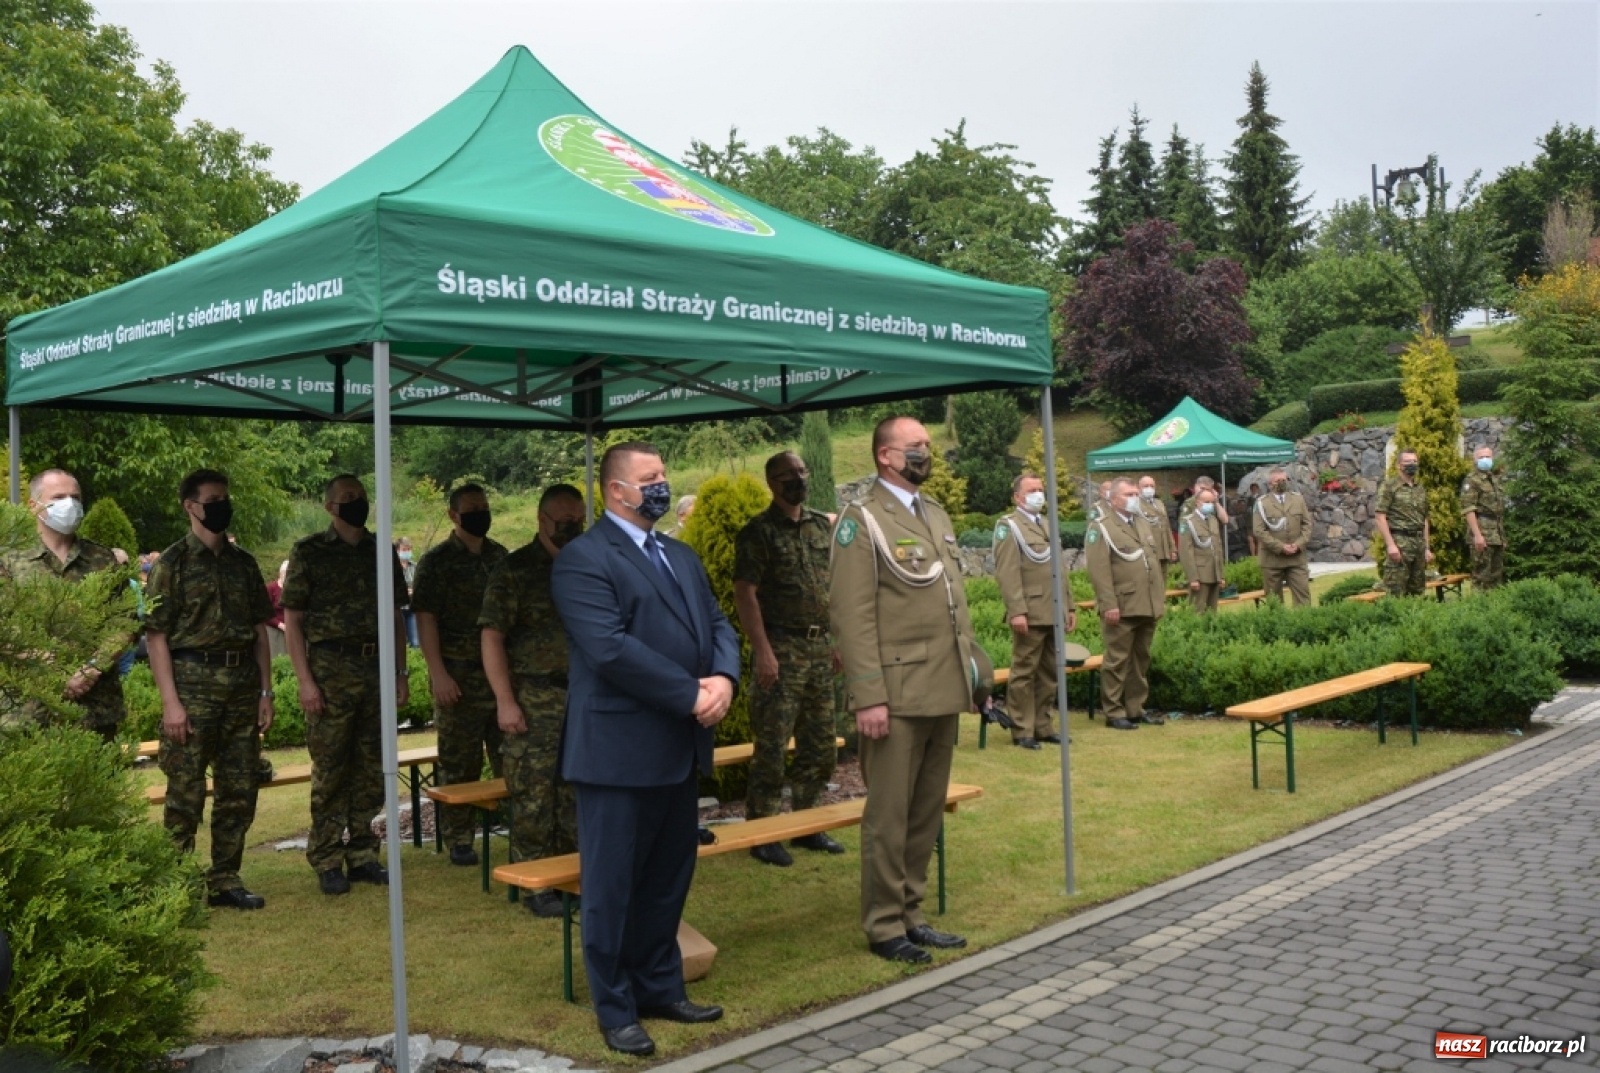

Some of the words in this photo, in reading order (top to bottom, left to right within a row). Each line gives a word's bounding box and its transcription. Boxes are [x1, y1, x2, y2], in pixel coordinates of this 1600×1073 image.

[46, 337, 80, 362] Oddział
[82, 329, 113, 352] Straży
[115, 311, 175, 344] Granicznej
[177, 313, 185, 330] z
[187, 300, 242, 329] siedzibą
[245, 298, 258, 315] w
[262, 277, 343, 312] Raciborzu
[437, 263, 526, 302] Śląski
[535, 277, 634, 308] Oddział
[641, 288, 716, 321] Straży
[722, 296, 834, 331] Granicznej
[838, 313, 849, 329] z
[854, 312, 927, 342] siedzibą
[932, 324, 947, 339] w
[951, 322, 1027, 348] Raciborzu
